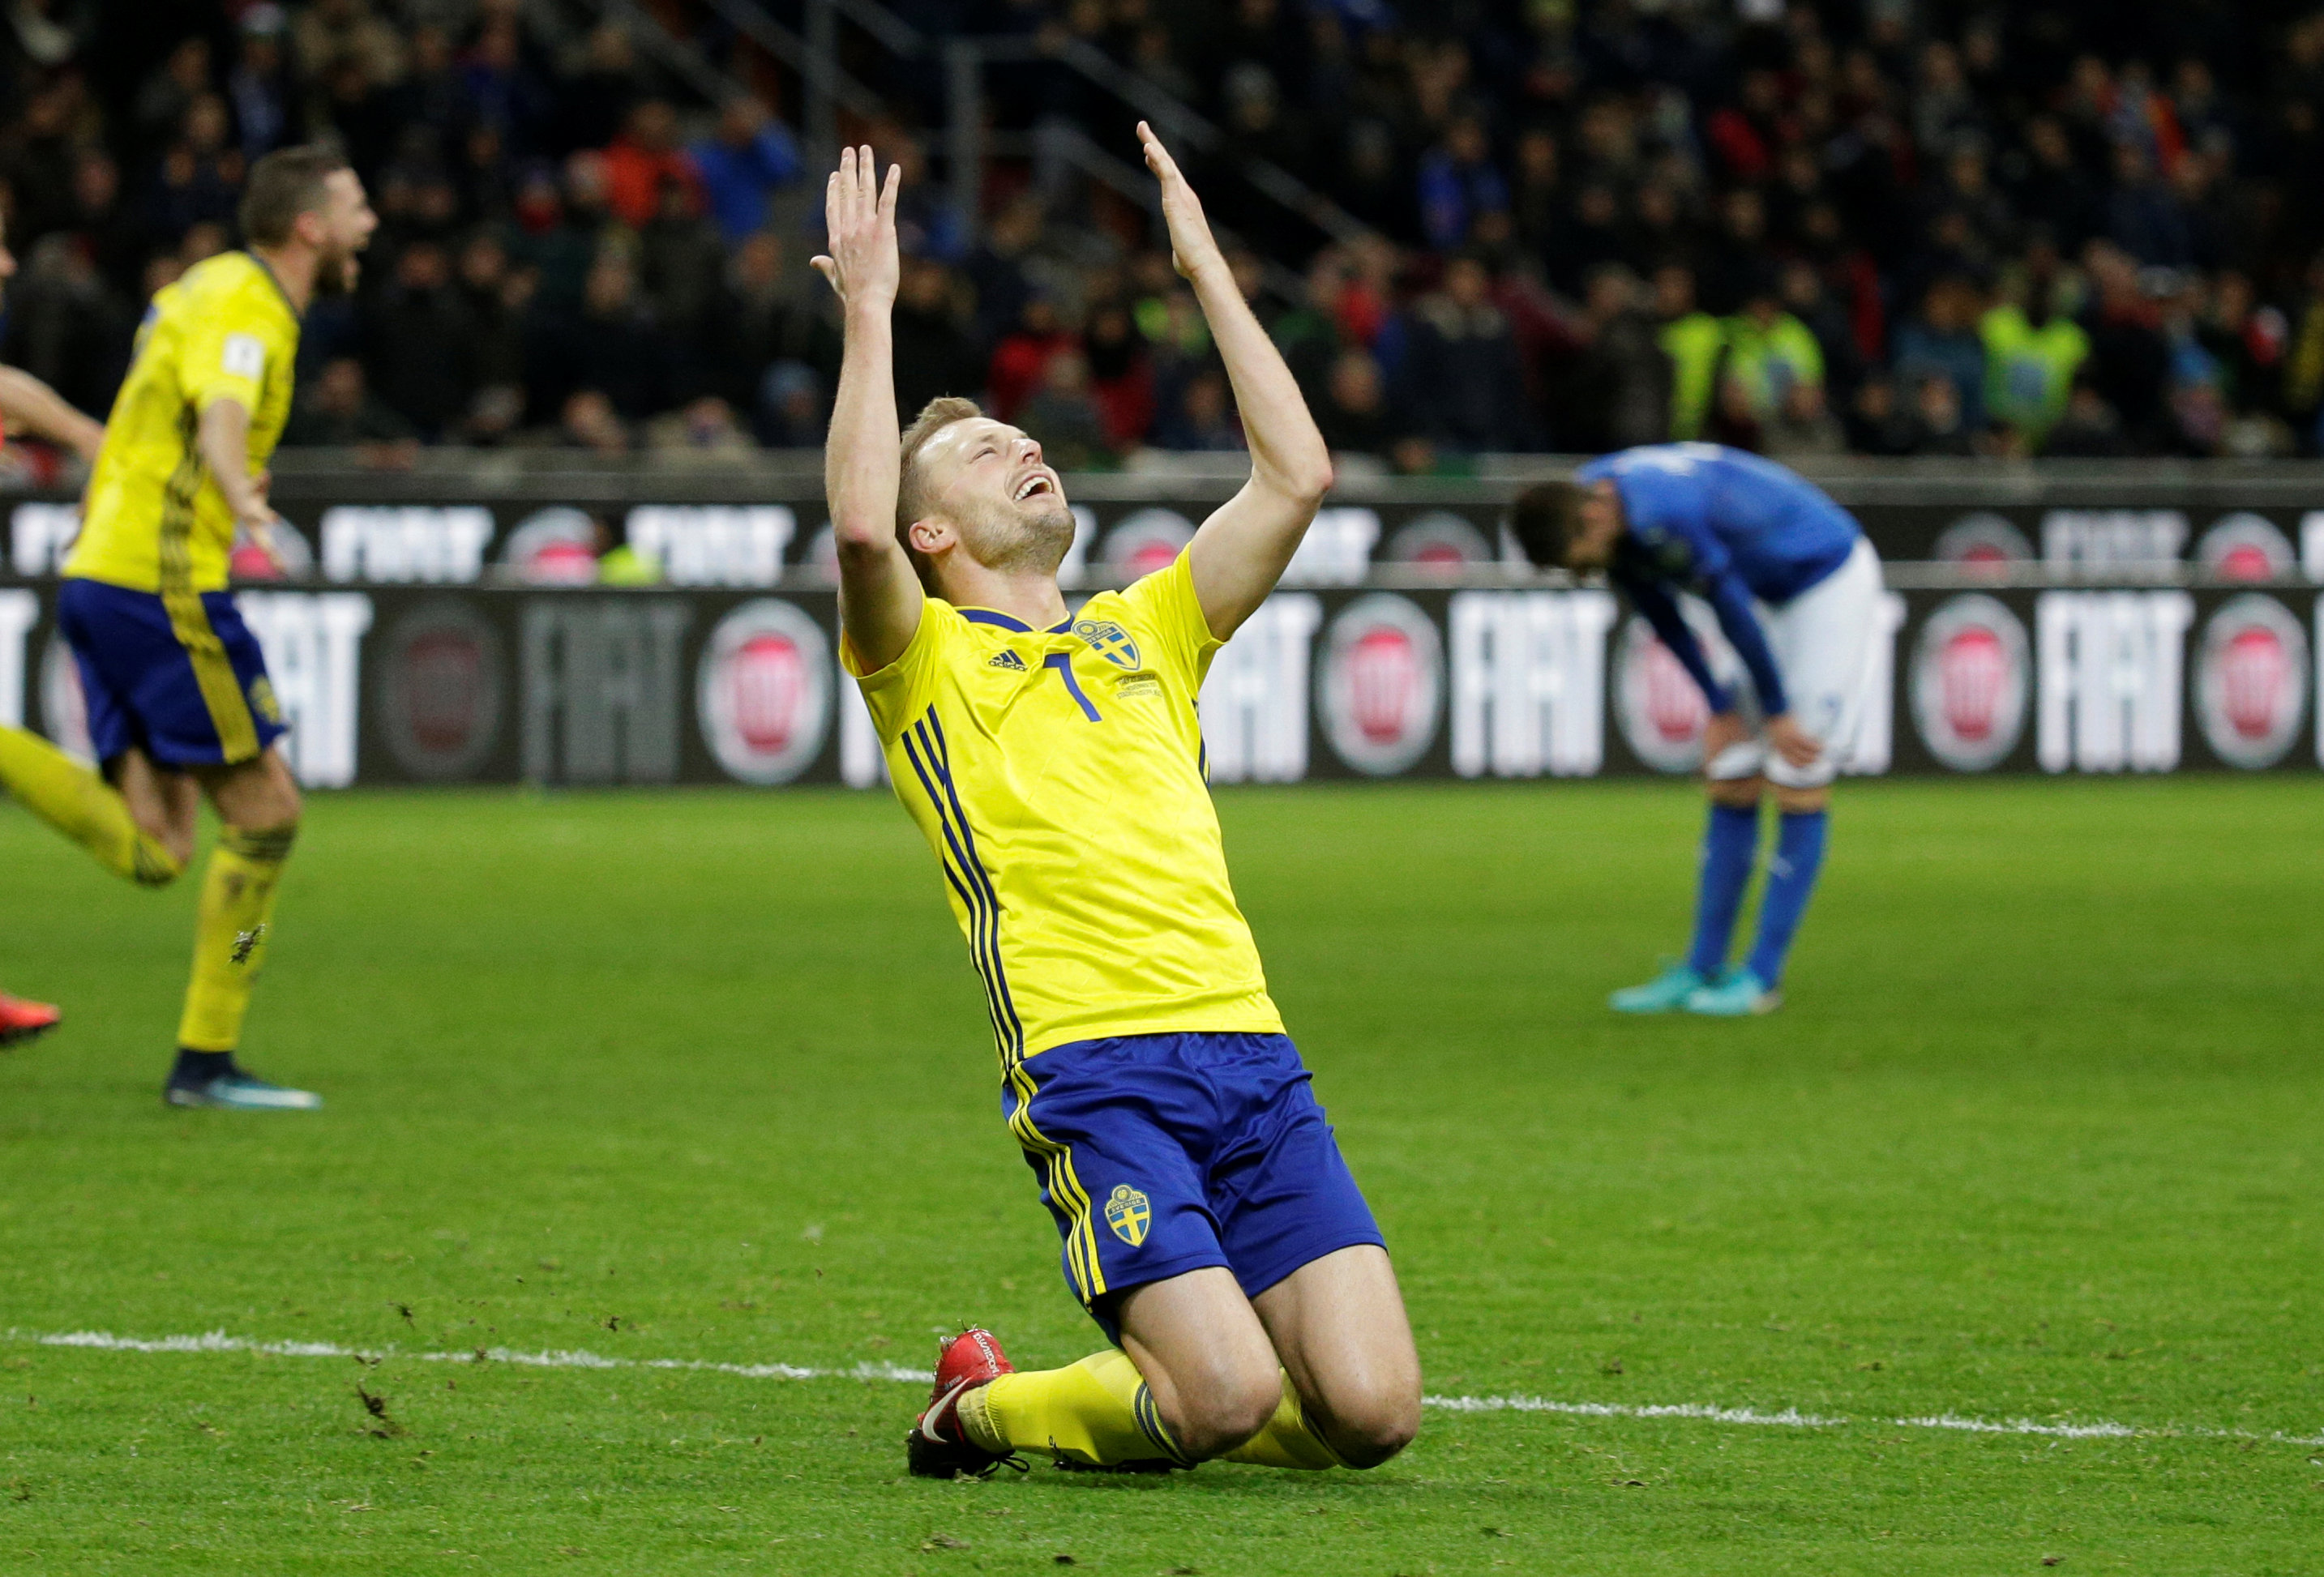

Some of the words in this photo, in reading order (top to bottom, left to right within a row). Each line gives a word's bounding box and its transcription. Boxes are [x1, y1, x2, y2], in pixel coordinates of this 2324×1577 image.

[1043, 652, 1102, 722] 7
[1449, 591, 1620, 780] FIAT
[2036, 590, 2193, 774] FIAT
